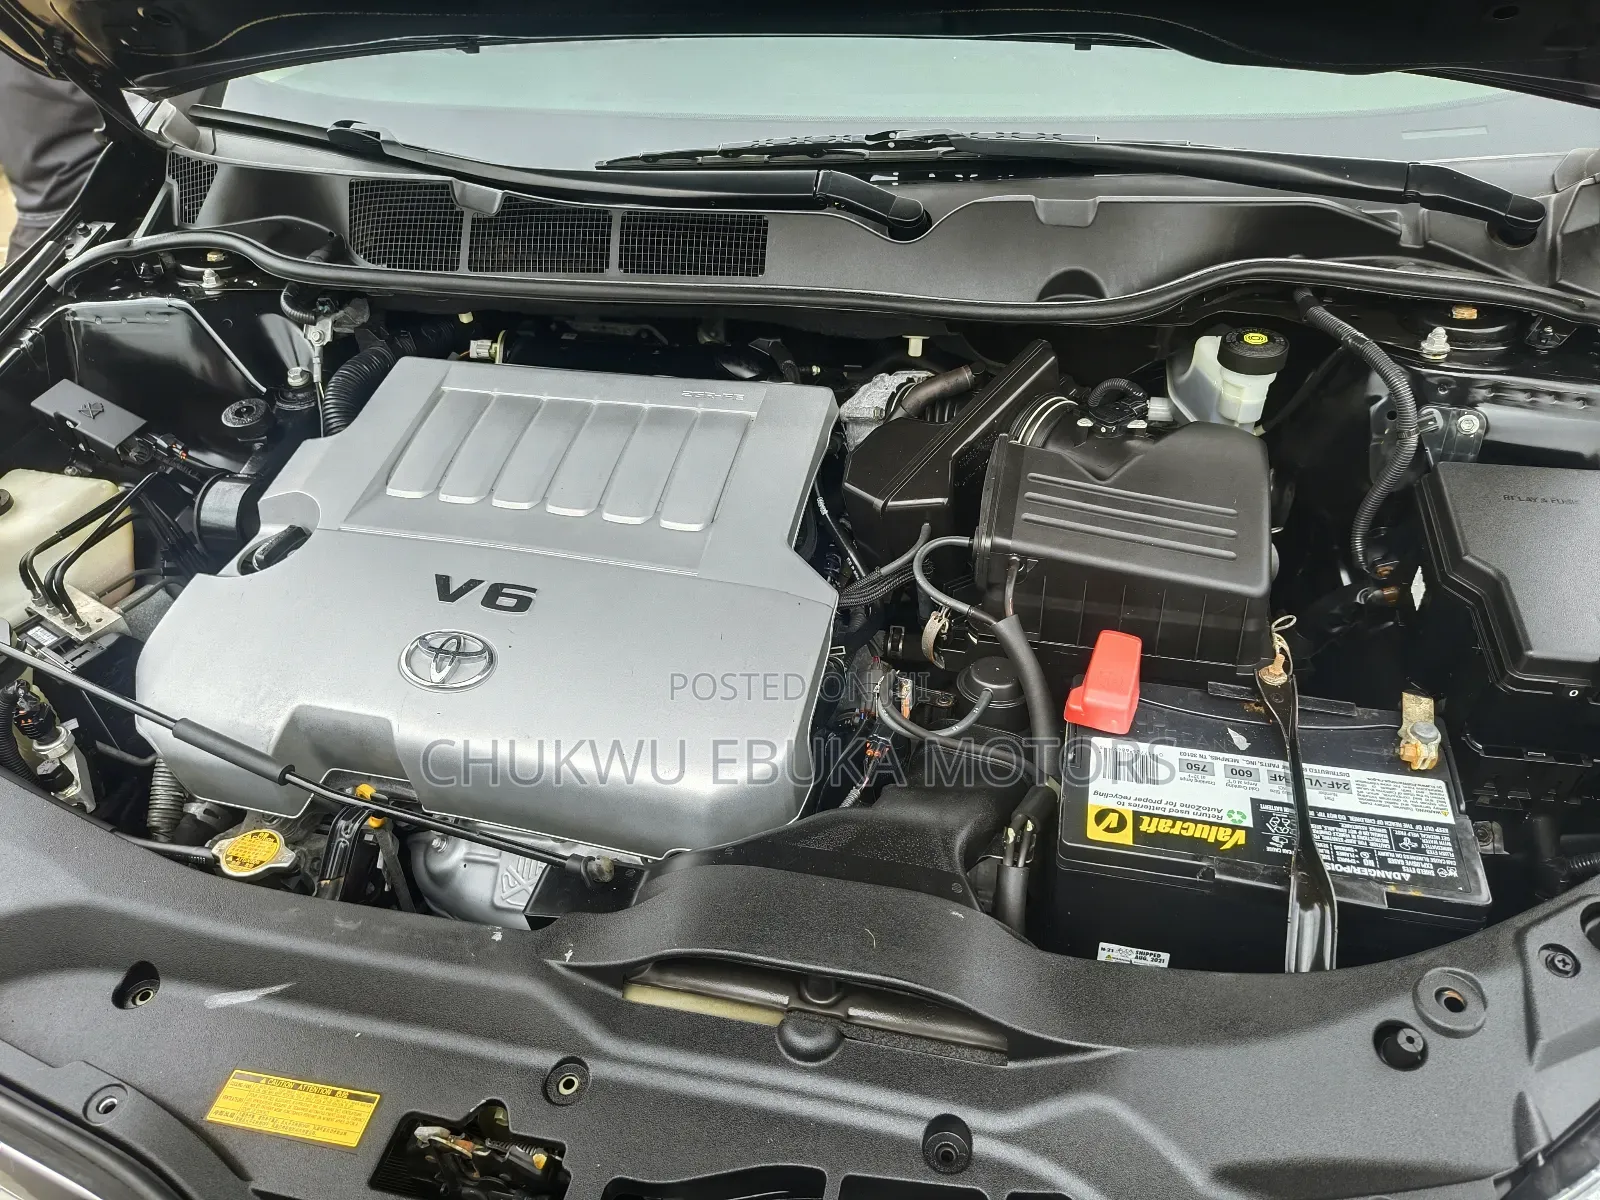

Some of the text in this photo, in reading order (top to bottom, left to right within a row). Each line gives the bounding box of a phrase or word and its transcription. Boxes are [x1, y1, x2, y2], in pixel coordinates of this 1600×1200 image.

[434, 573, 538, 613] V6
[1186, 762, 1208, 773] 750
[1309, 768, 1350, 777] DISTRIBUTED
[1230, 768, 1252, 778] 600
[1093, 790, 1131, 801] recycling
[1134, 796, 1163, 804] proper
[1128, 801, 1166, 812] batteries
[1180, 803, 1223, 813] AutoZone
[1168, 808, 1190, 816] used
[1193, 811, 1223, 820] Return
[1139, 816, 1246, 850] Valucraft
[1324, 863, 1400, 879] DANGER/POIS
[1135, 950, 1161, 958] SHIPPED
[268, 1079, 295, 1088] CAUTION
[298, 1084, 332, 1095] ATTENTION
